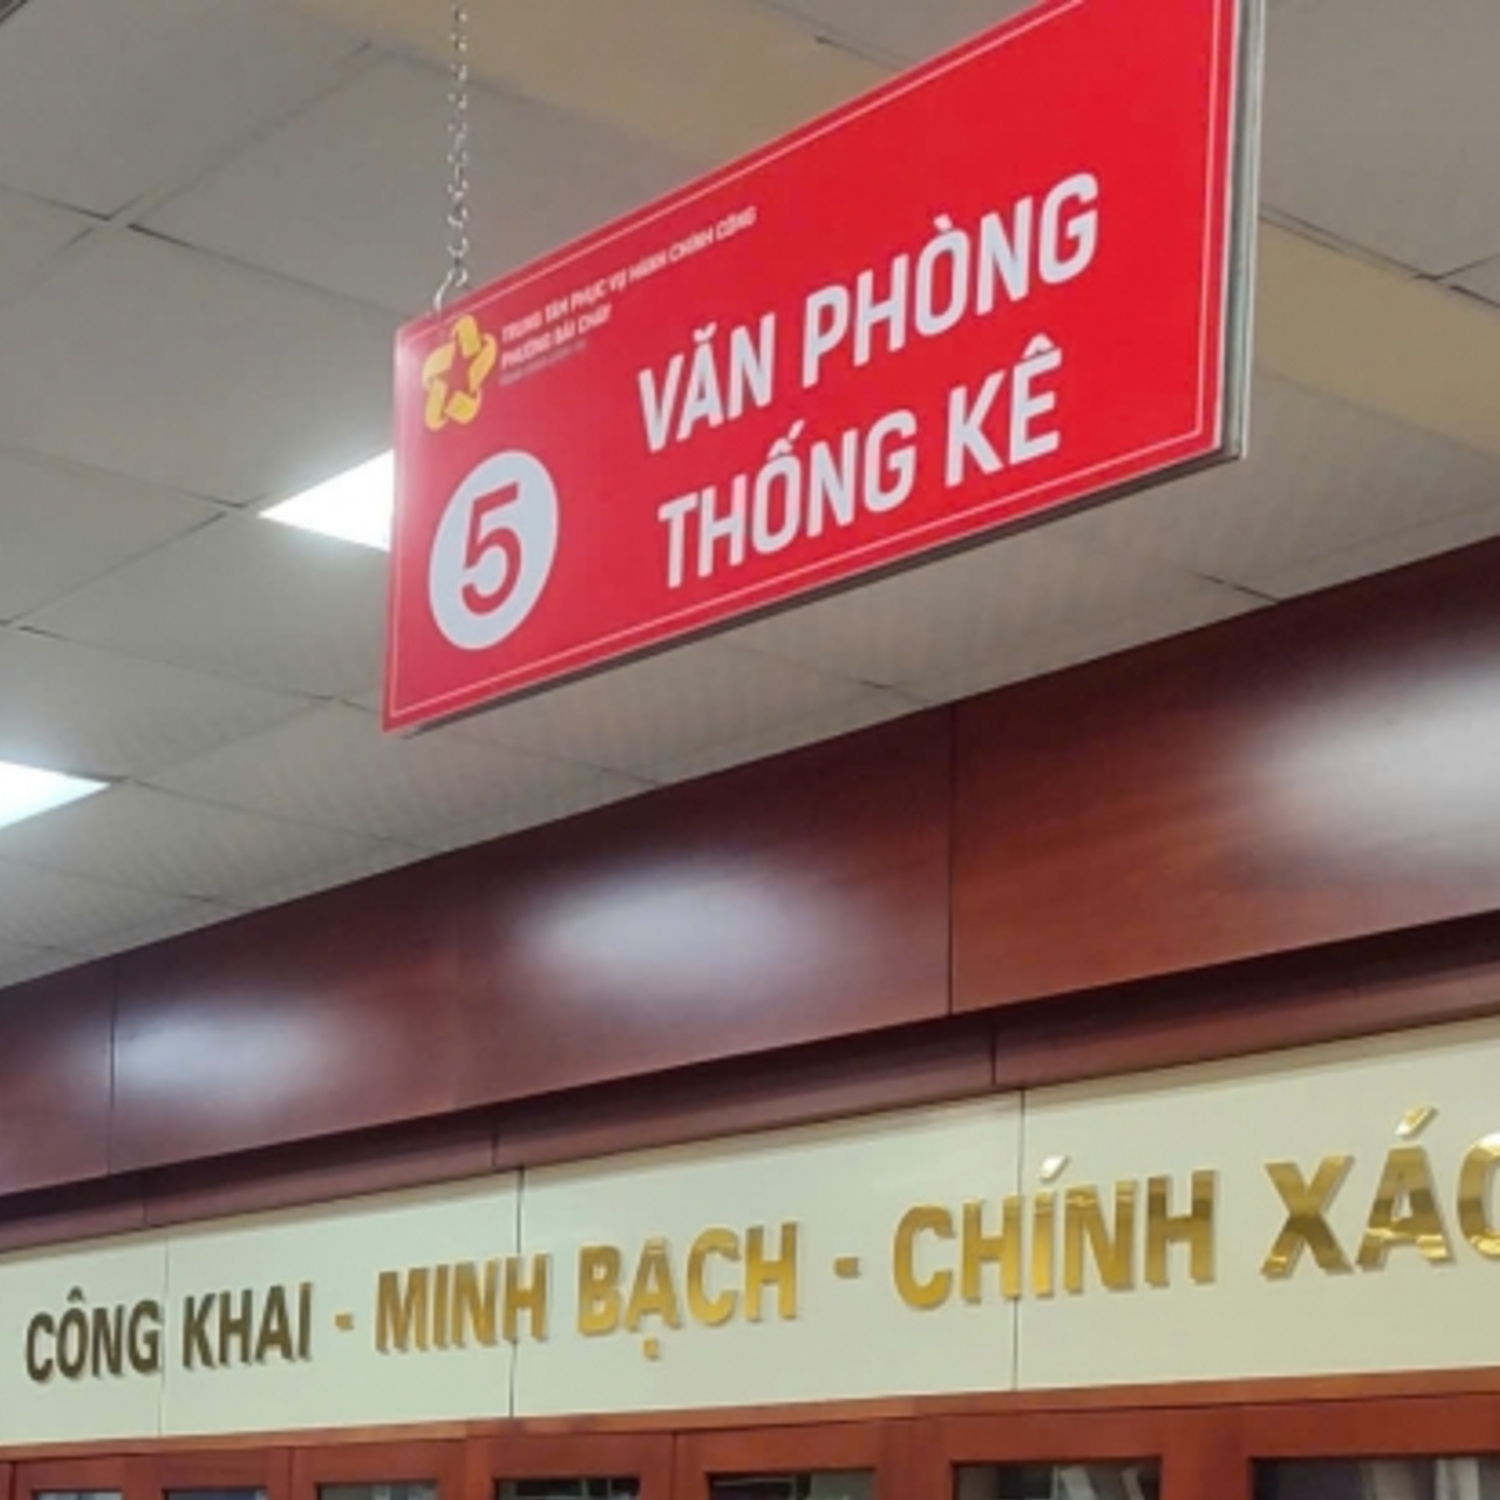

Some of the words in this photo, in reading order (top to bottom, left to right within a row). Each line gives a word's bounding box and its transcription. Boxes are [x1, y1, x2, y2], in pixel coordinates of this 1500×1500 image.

[637, 313, 776, 454] VĂN
[800, 172, 1099, 391] PHÒNG
[460, 483, 523, 617] 5
[657, 408, 917, 590] THỐNG
[944, 333, 1063, 489] KÊ
[25, 1285, 163, 1384] CÔNG
[181, 1281, 313, 1370] KHAI
[373, 1252, 551, 1355] MINH
[576, 1221, 800, 1360] BẠCH
[892, 1154, 1218, 1312] CHÍNH
